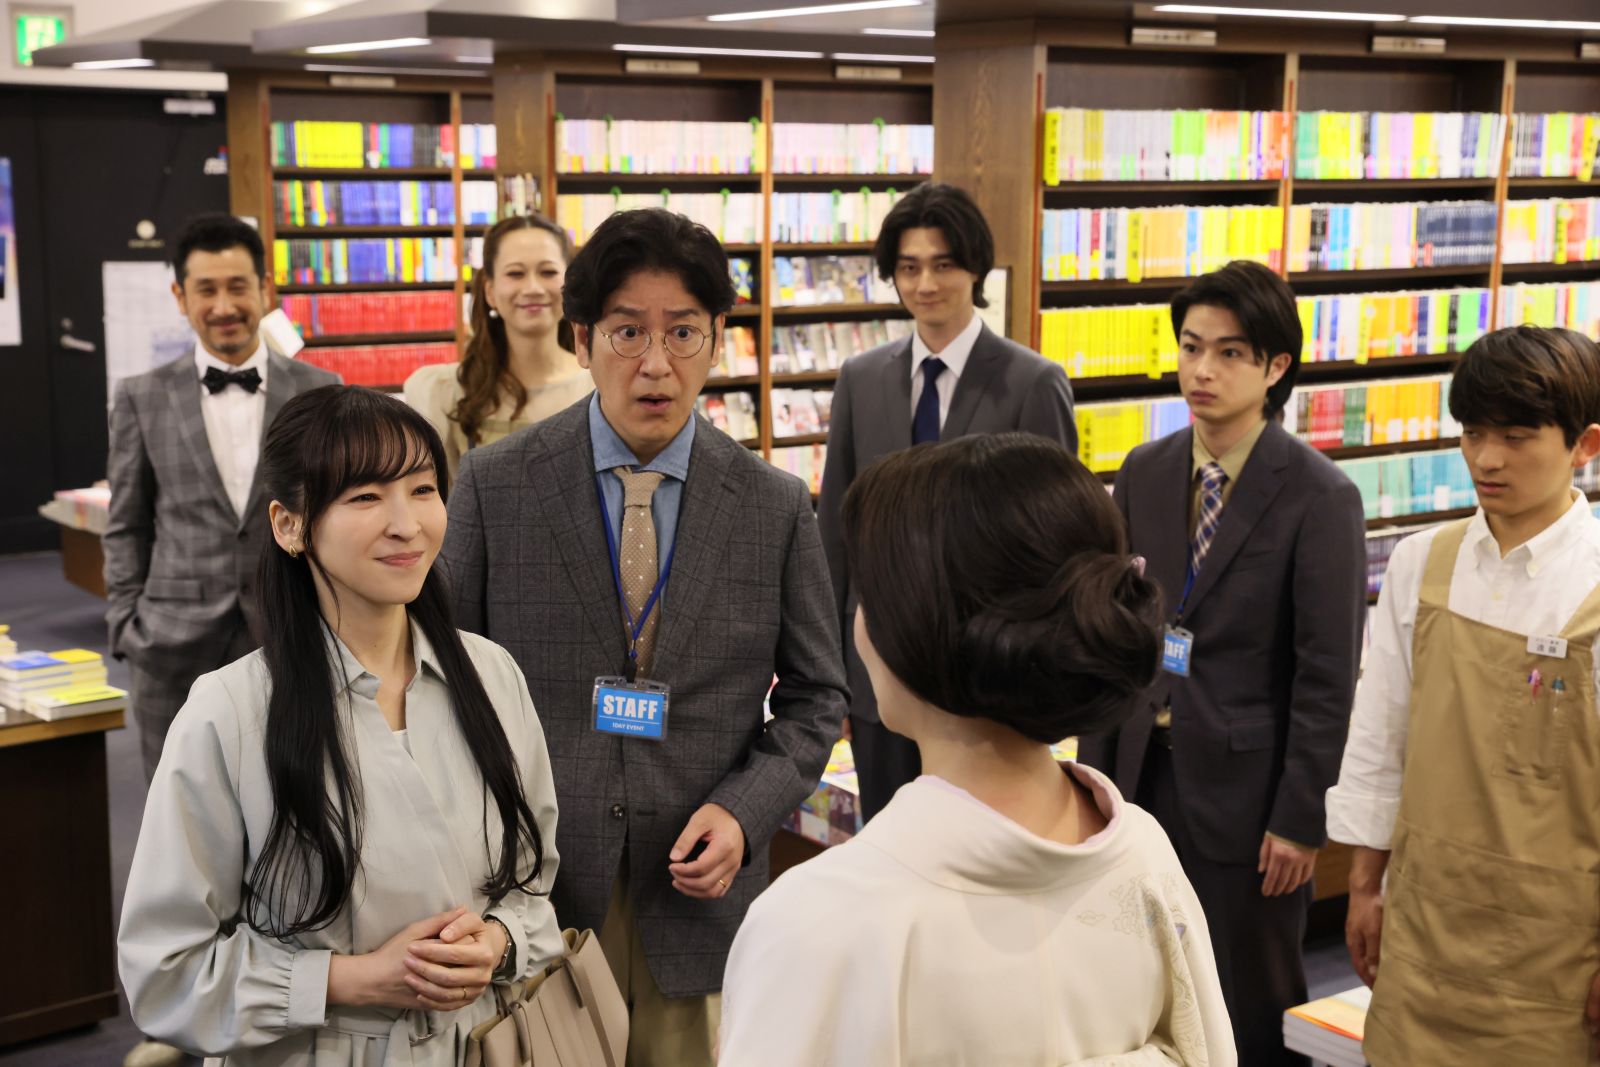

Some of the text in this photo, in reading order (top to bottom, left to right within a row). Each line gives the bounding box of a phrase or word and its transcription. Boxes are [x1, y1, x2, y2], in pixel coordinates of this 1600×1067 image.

[1164, 640, 1185, 660] TAFF
[603, 694, 658, 720] STAFF
[612, 722, 645, 732] 1DAY EVENT
